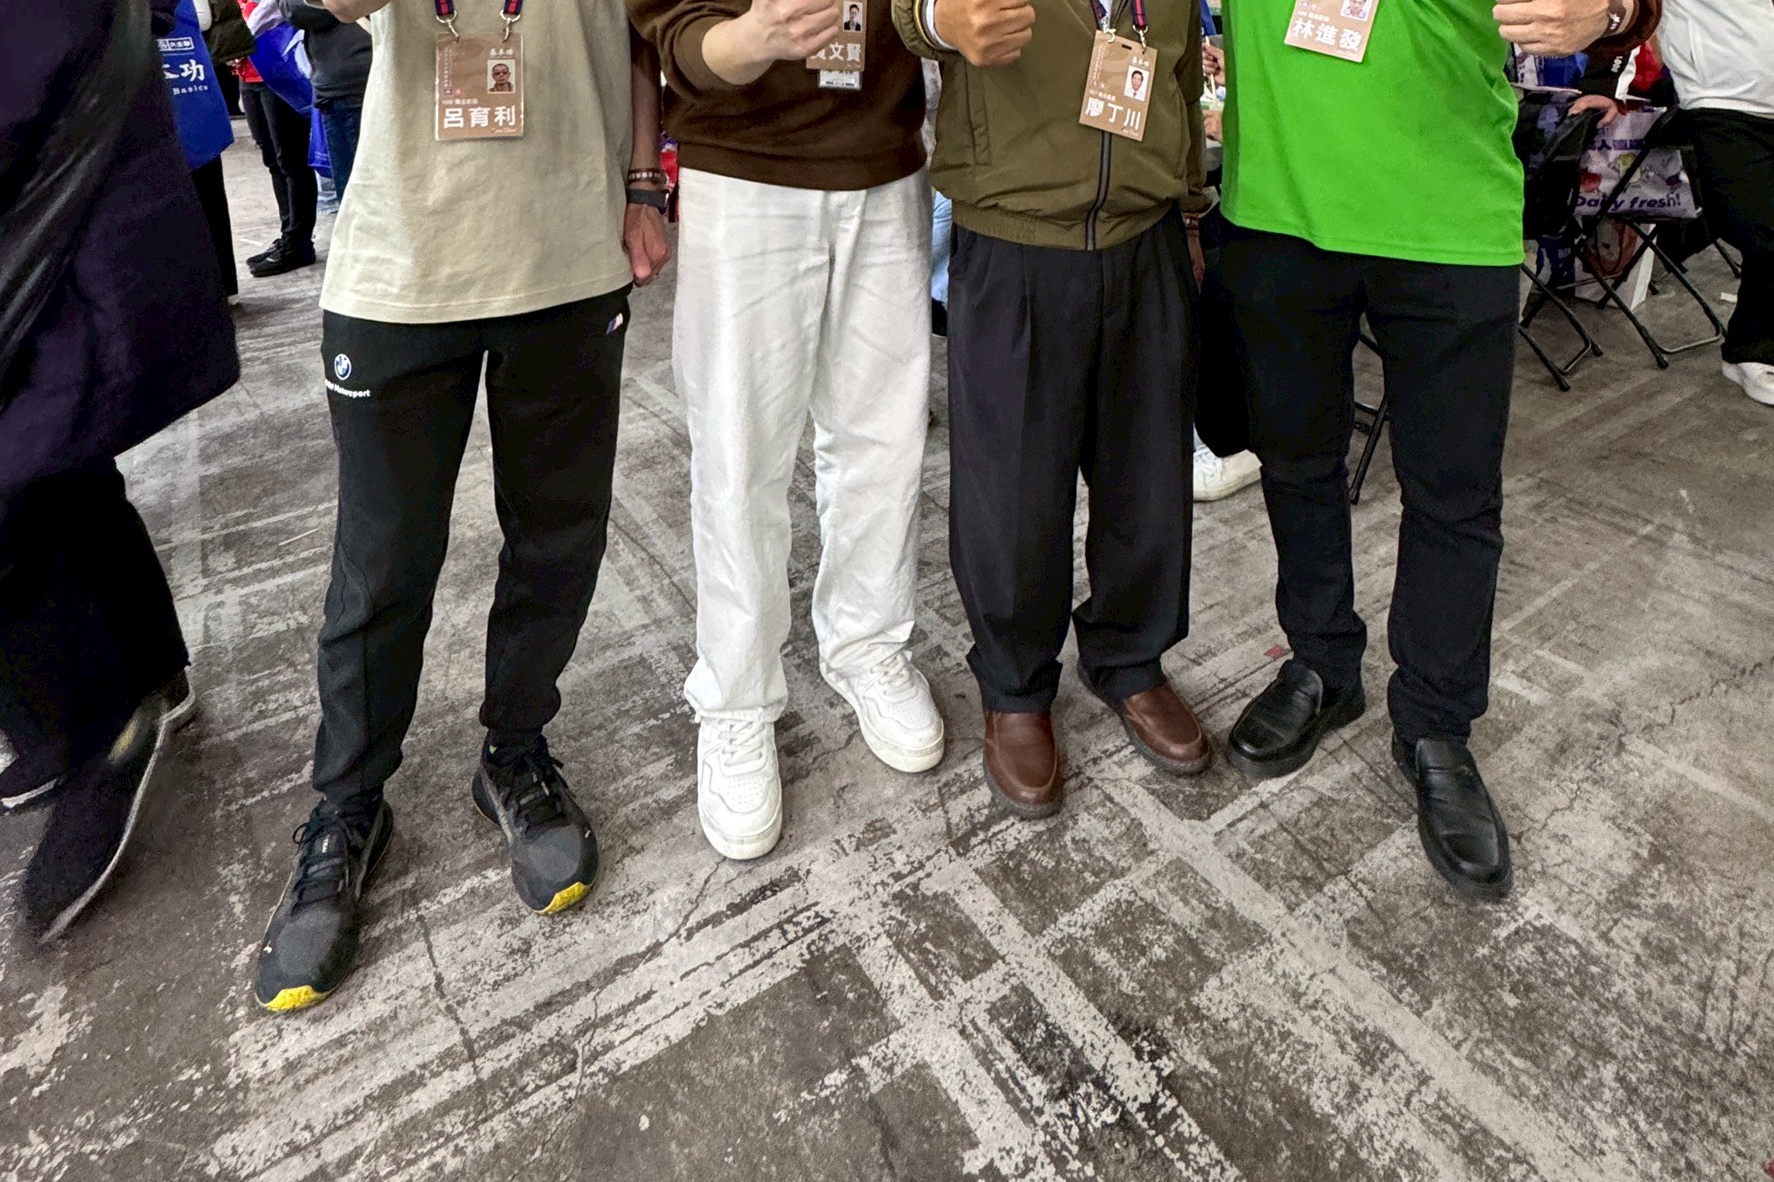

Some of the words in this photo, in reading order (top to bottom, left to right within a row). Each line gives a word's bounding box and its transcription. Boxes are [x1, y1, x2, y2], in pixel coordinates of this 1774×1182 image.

[1292, 18, 1362, 52] 林進發
[443, 105, 516, 129] 呂育利
[1630, 193, 1681, 210] fresh!
